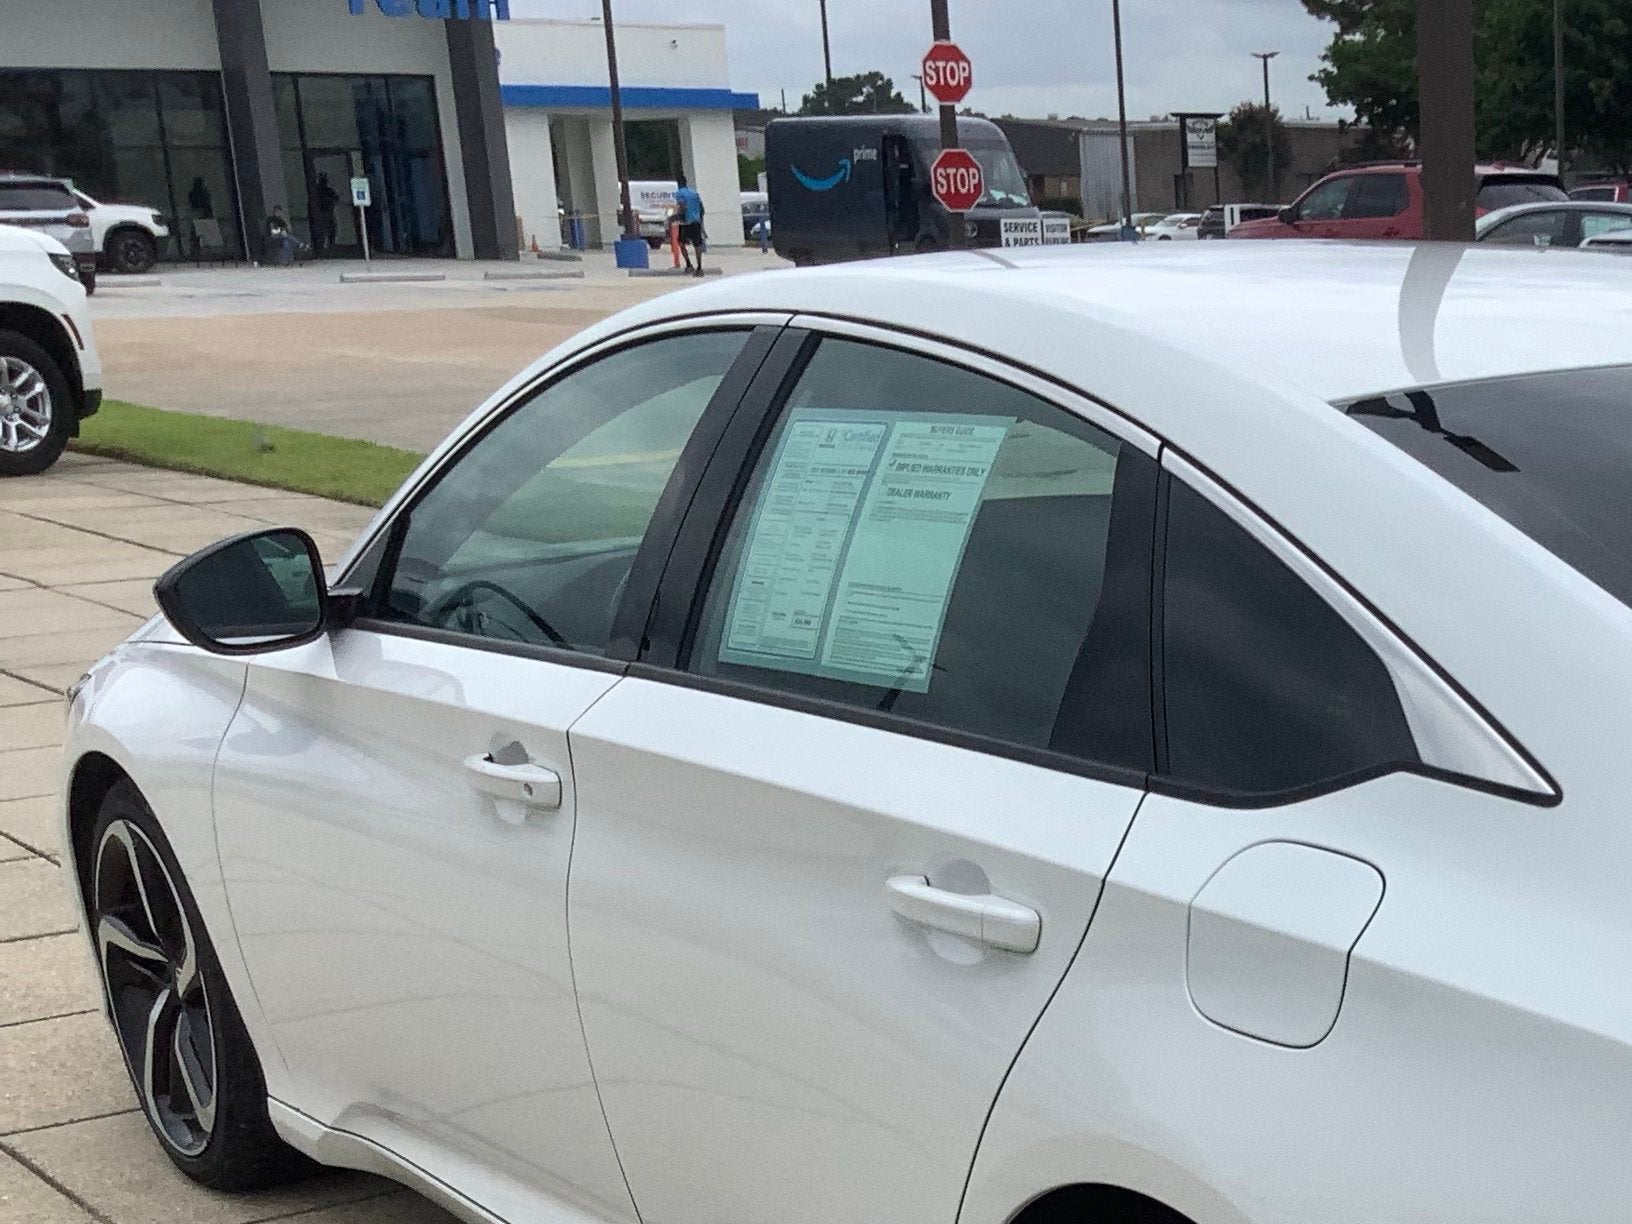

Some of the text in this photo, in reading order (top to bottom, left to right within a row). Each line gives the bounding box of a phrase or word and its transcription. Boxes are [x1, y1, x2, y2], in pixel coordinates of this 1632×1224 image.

[925, 60, 970, 88] STOP
[853, 145, 878, 164] prime
[936, 167, 979, 195] STOP
[1004, 222, 1038, 233] SERVICE
